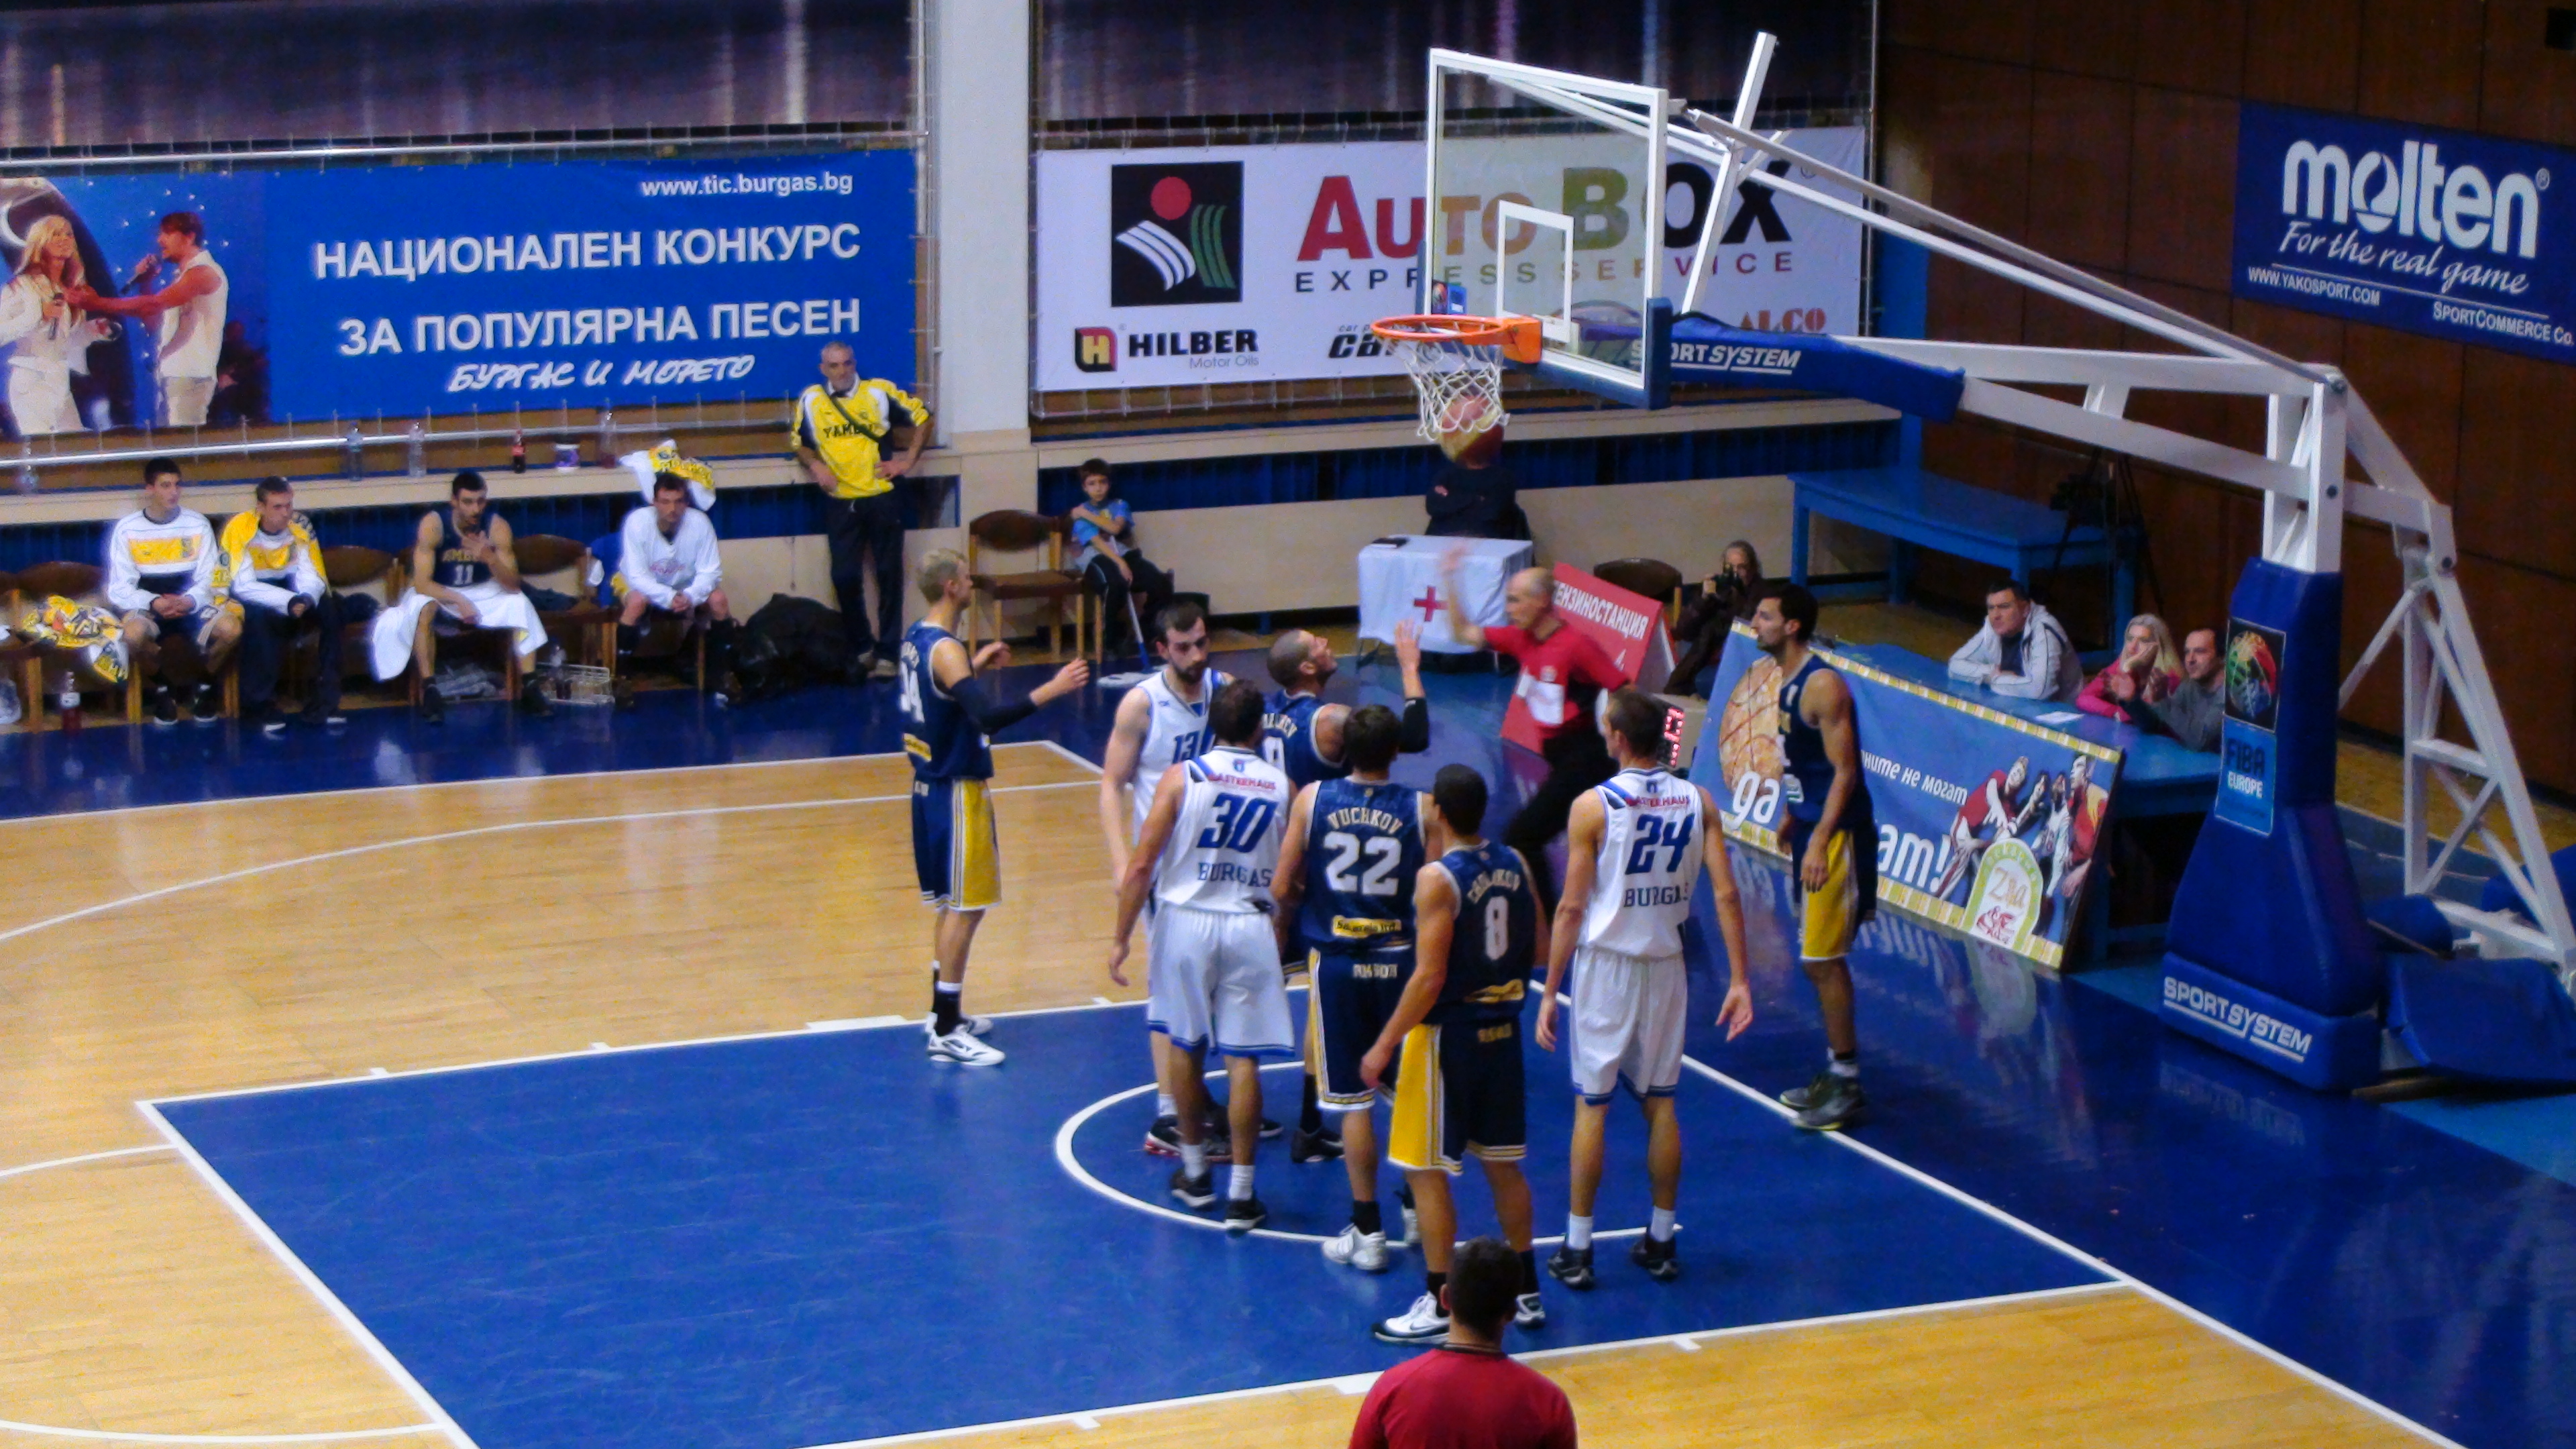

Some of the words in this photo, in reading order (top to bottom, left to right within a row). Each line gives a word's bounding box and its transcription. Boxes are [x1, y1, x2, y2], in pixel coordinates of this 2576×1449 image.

[641, 172, 853, 197] www.tic.burgas.bg
[2282, 140, 2539, 260] molten
[315, 231, 641, 282] НАЦИОНАЛЕН
[657, 223, 861, 266] КОНКУРС
[2279, 220, 2326, 253] For
[2327, 229, 2375, 264] the
[2379, 245, 2444, 277] real
[2440, 260, 2529, 295] game
[339, 319, 402, 356] ЗА
[415, 305, 699, 354] ПОПУЛЯРНА
[711, 299, 861, 340] ПЕСЕН
[1128, 329, 1259, 358] HILBER
[1709, 344, 1802, 369] SYSTEM
[1189, 356, 1231, 369] Motor
[1234, 355, 1260, 367] Oils
[1552, 579, 1650, 641] ЕНЗИНОСТАНЦИЯ
[2227, 770, 2263, 799] EUROPE
[1196, 792, 1279, 853] 30
[1326, 806, 1403, 835] VUCHKOV
[1625, 812, 1696, 875] 24
[1197, 861, 1273, 888] BURGAS
[1323, 830, 1402, 896] 22
[1485, 895, 1509, 961] 8
[2163, 976, 2229, 1020] SPORT
[2227, 1003, 2313, 1055] SYSTEM
